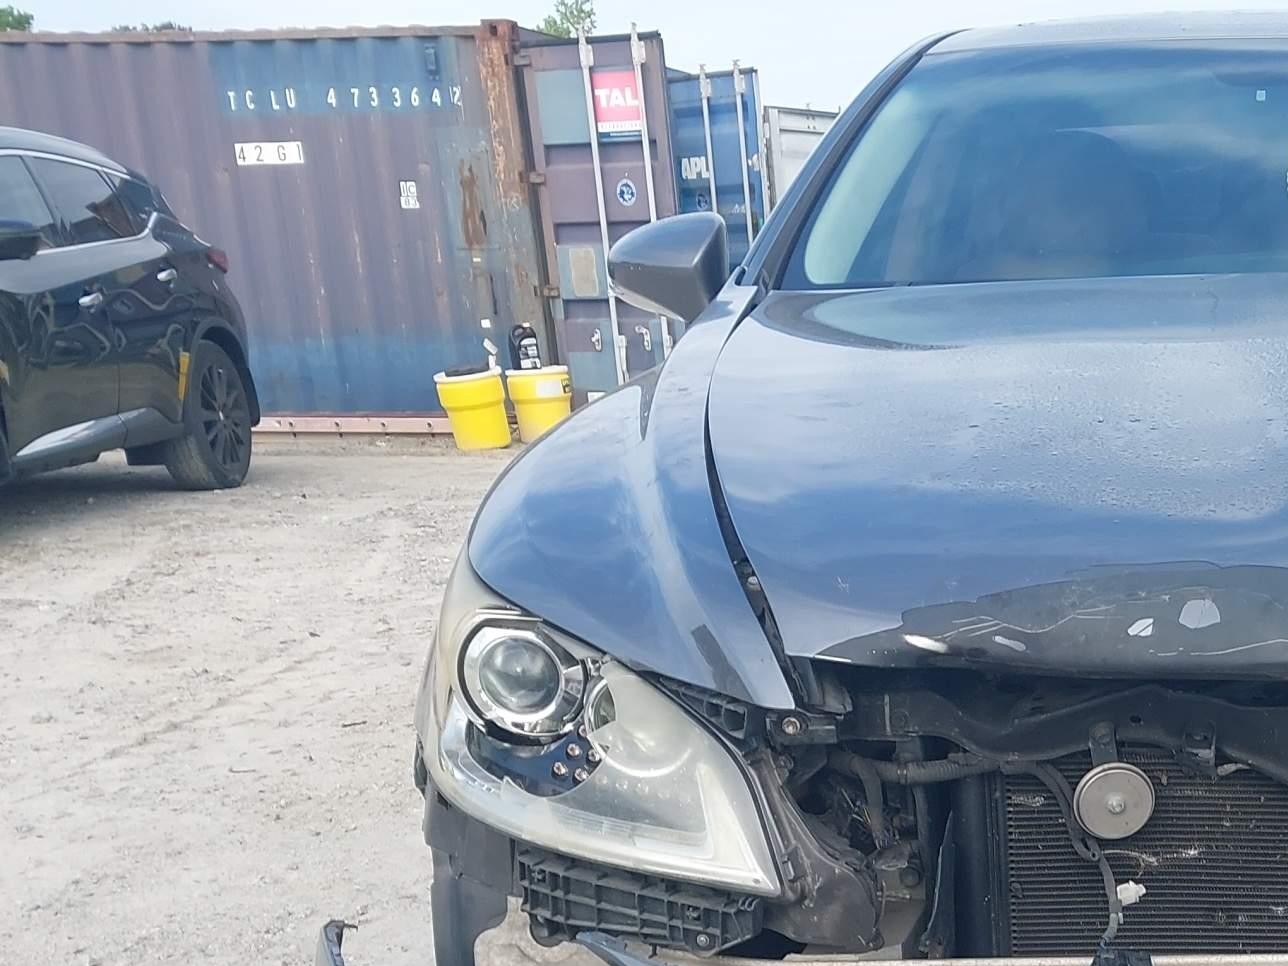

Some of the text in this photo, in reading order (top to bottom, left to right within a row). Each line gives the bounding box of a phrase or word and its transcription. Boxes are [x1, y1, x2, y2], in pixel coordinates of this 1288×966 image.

[227, 87, 296, 112] TCLU
[594, 86, 640, 108] TAL
[681, 156, 710, 180] APL
